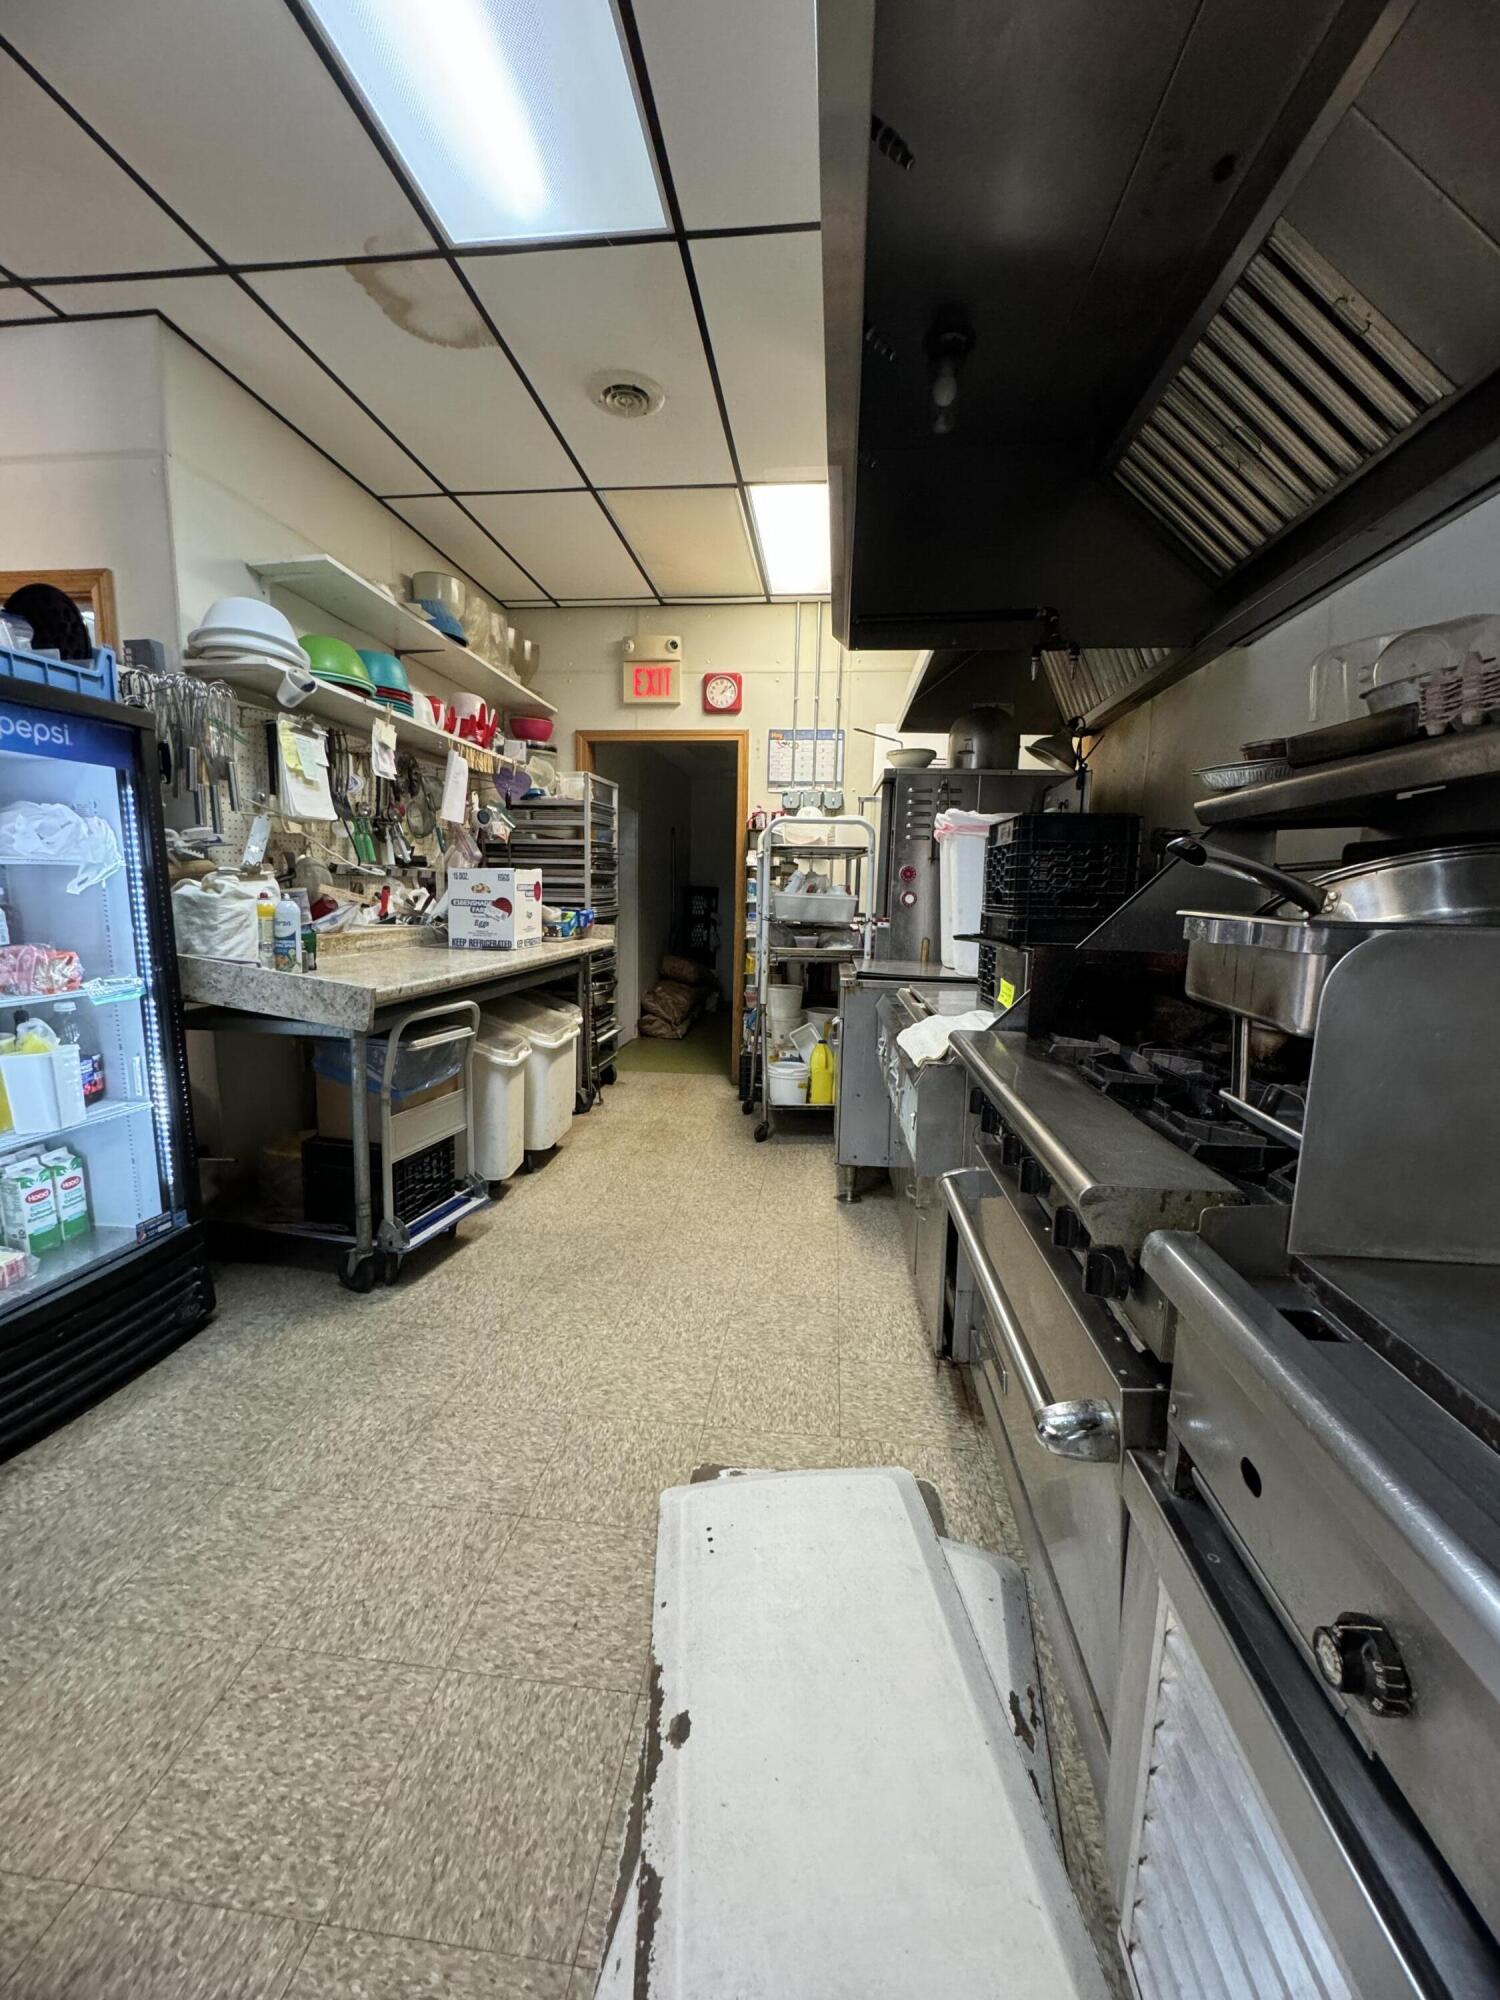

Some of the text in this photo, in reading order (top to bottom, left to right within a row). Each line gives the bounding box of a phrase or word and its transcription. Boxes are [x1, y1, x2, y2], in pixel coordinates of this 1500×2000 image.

[633, 667, 672, 697] EXIT
[0, 715, 70, 746] pepsi
[452, 938, 467, 947] KEEP
[469, 938, 513, 949] REFRIGERATED
[62, 1177, 81, 1189] Hood
[27, 1190, 50, 1203] Hood
